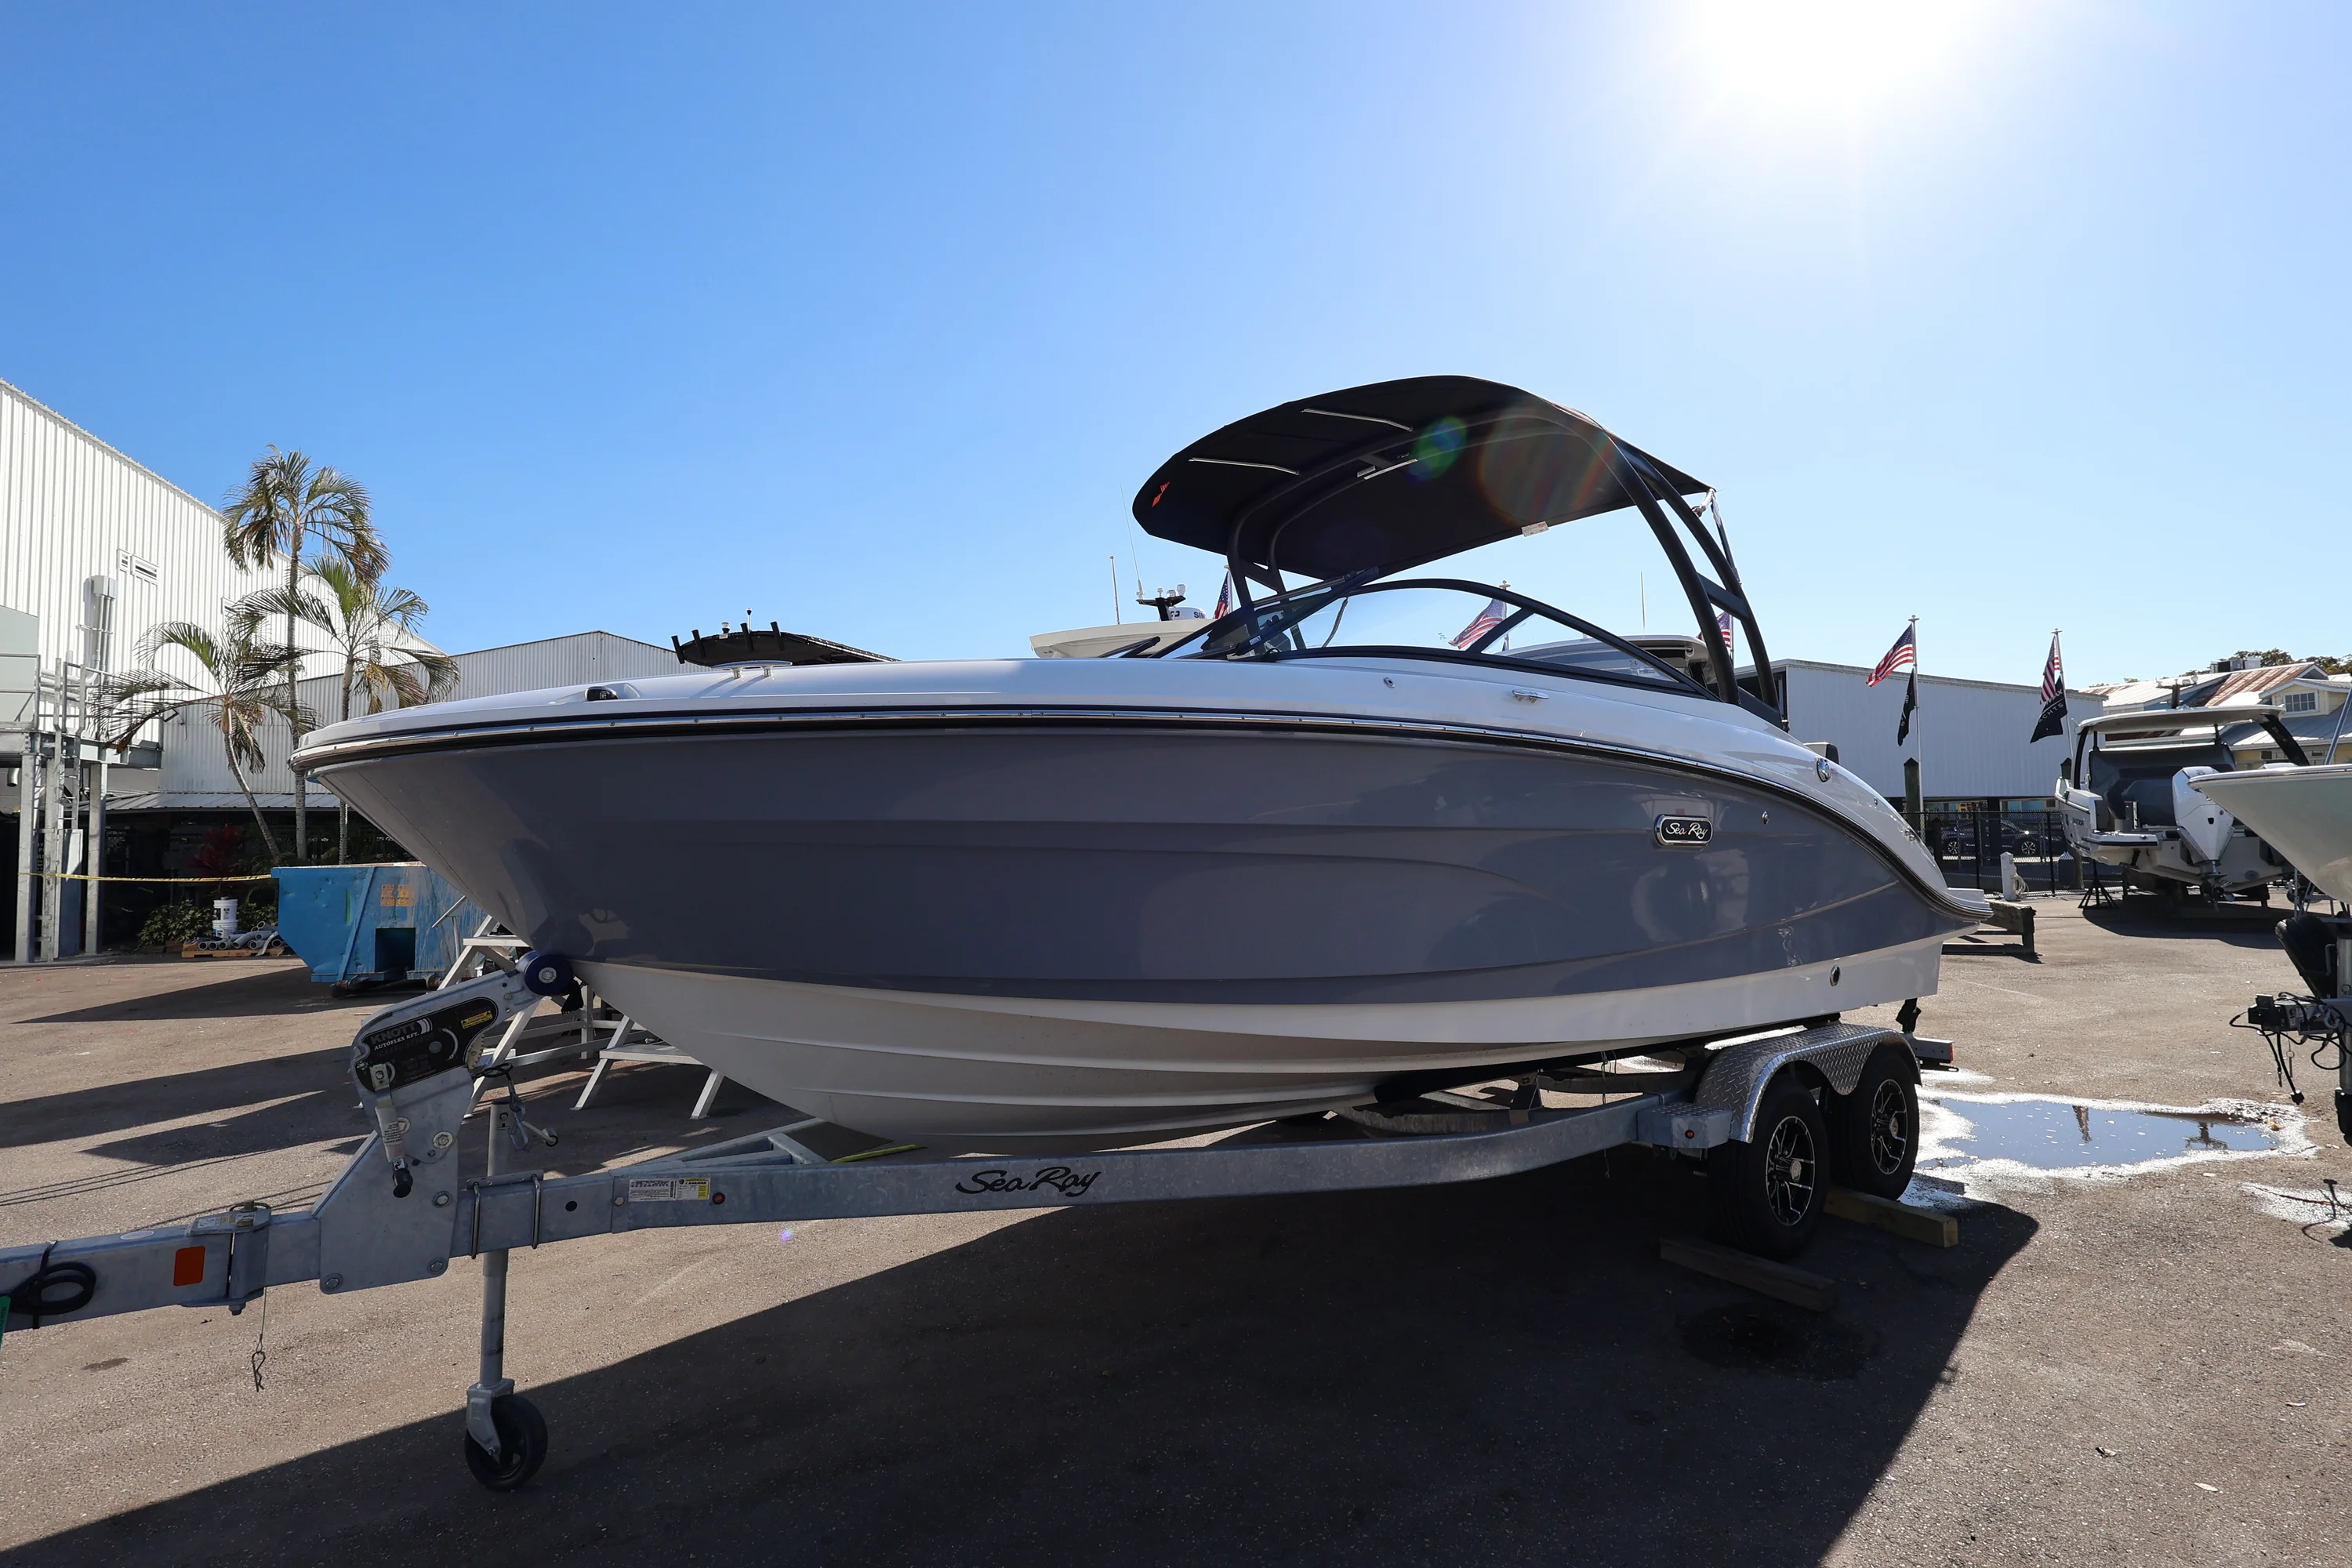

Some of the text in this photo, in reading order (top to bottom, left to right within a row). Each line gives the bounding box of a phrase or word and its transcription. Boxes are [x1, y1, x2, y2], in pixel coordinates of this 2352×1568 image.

[1665, 822, 1708, 840] Sea Ray
[370, 1022, 416, 1045] KNOTT
[955, 1166, 1102, 1197] Sea Ray
